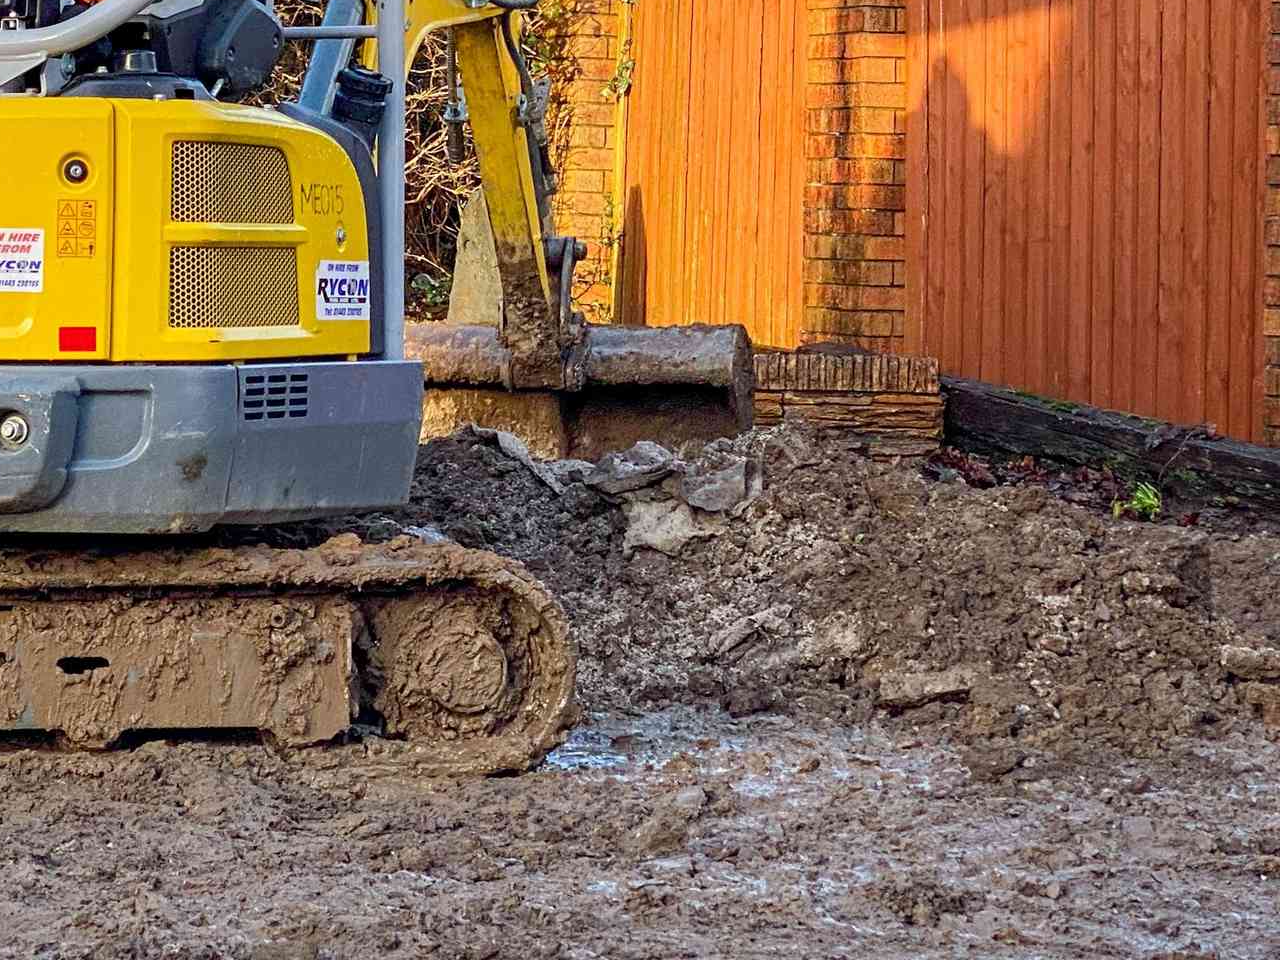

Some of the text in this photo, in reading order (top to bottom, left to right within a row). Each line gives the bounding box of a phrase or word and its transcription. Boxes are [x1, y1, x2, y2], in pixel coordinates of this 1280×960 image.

[300, 183, 345, 215] ME015
[8, 232, 41, 242] HIRE
[318, 278, 368, 303] RYCON
